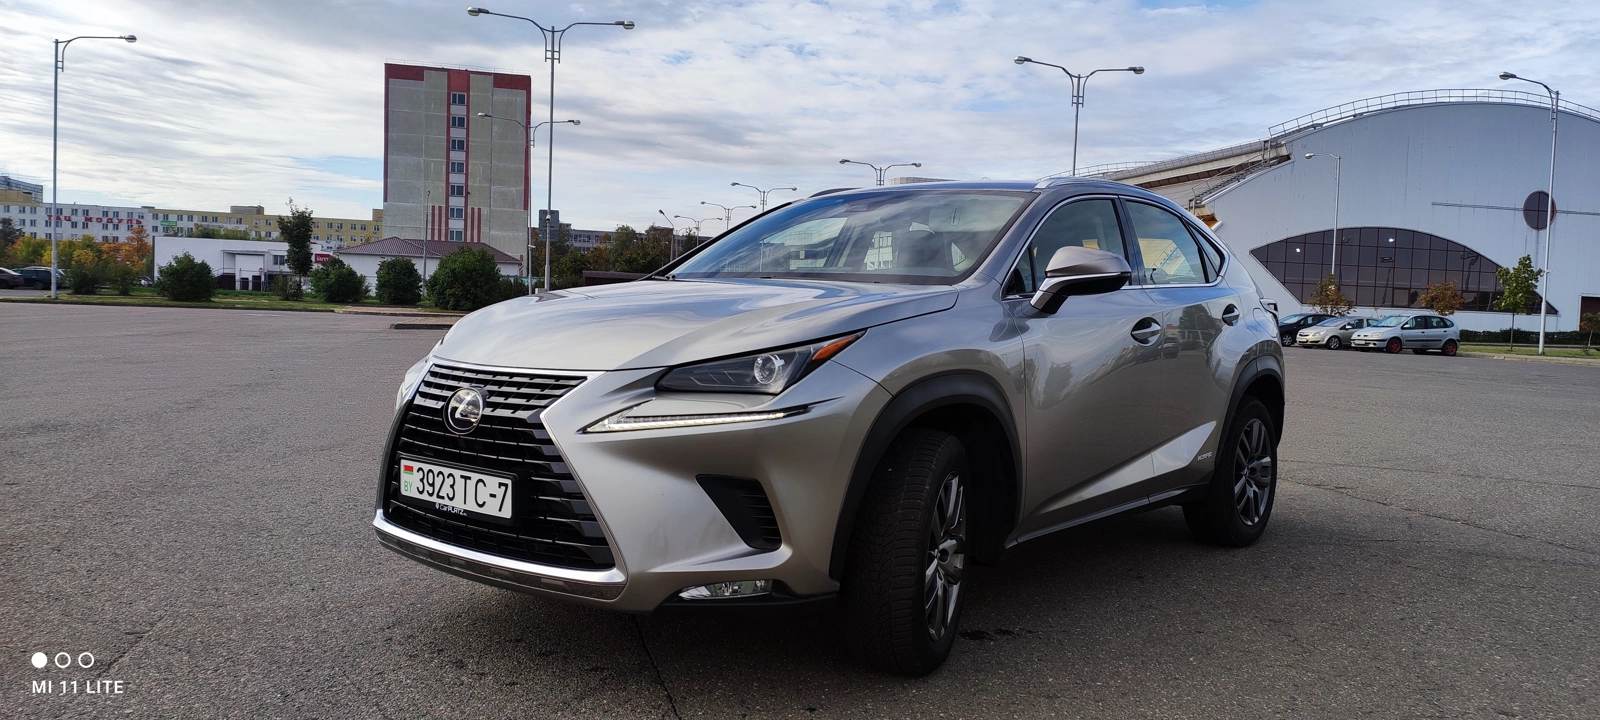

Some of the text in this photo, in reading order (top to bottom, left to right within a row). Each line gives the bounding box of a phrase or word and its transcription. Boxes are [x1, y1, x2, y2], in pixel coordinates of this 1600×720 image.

[84, 216, 143, 225] МОДУЛЬ
[403, 480, 414, 493] BY
[416, 466, 456, 502] 3923
